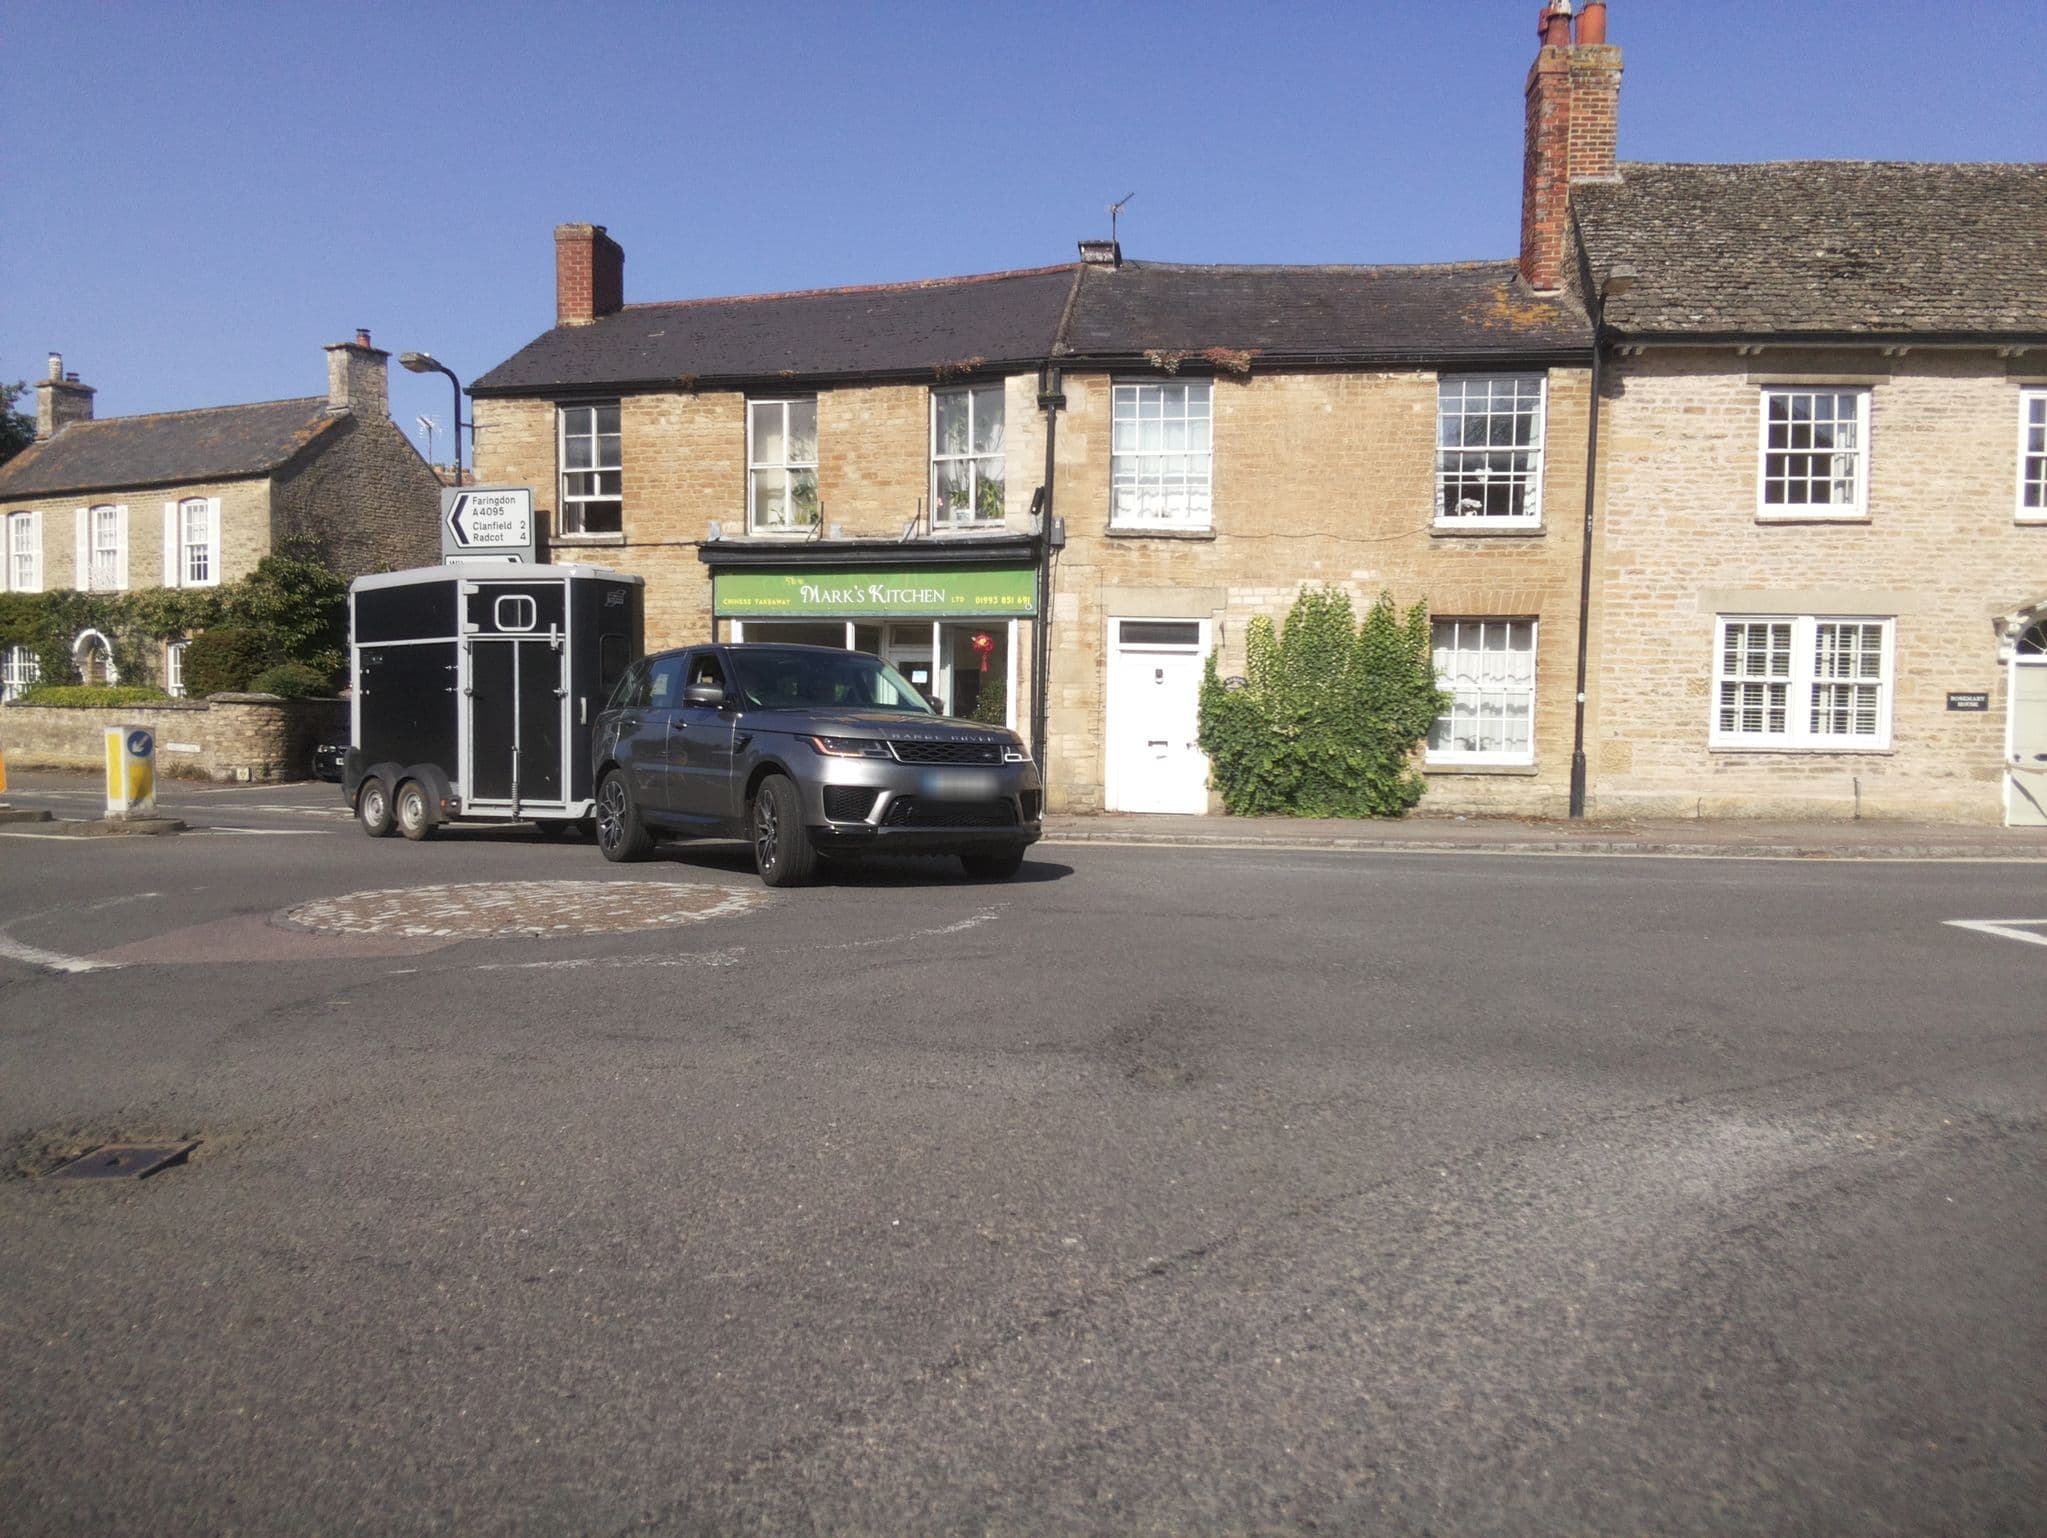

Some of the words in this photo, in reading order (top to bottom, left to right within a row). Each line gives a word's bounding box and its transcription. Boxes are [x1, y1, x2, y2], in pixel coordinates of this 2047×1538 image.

[472, 496, 516, 506] Faringdon
[472, 507, 505, 516] A4095
[472, 521, 512, 531] Clanfield
[520, 520, 526, 530] 2
[473, 533, 504, 542] Radcot
[520, 532, 526, 541] 4
[800, 584, 865, 603] MARK'S
[868, 584, 945, 603] KITCHEN
[722, 598, 751, 606] CHINESE
[755, 598, 791, 606] TAKEAWAY
[975, 596, 998, 605] 01993
[1001, 595, 1015, 604] 851
[951, 734, 996, 742] ROVER
